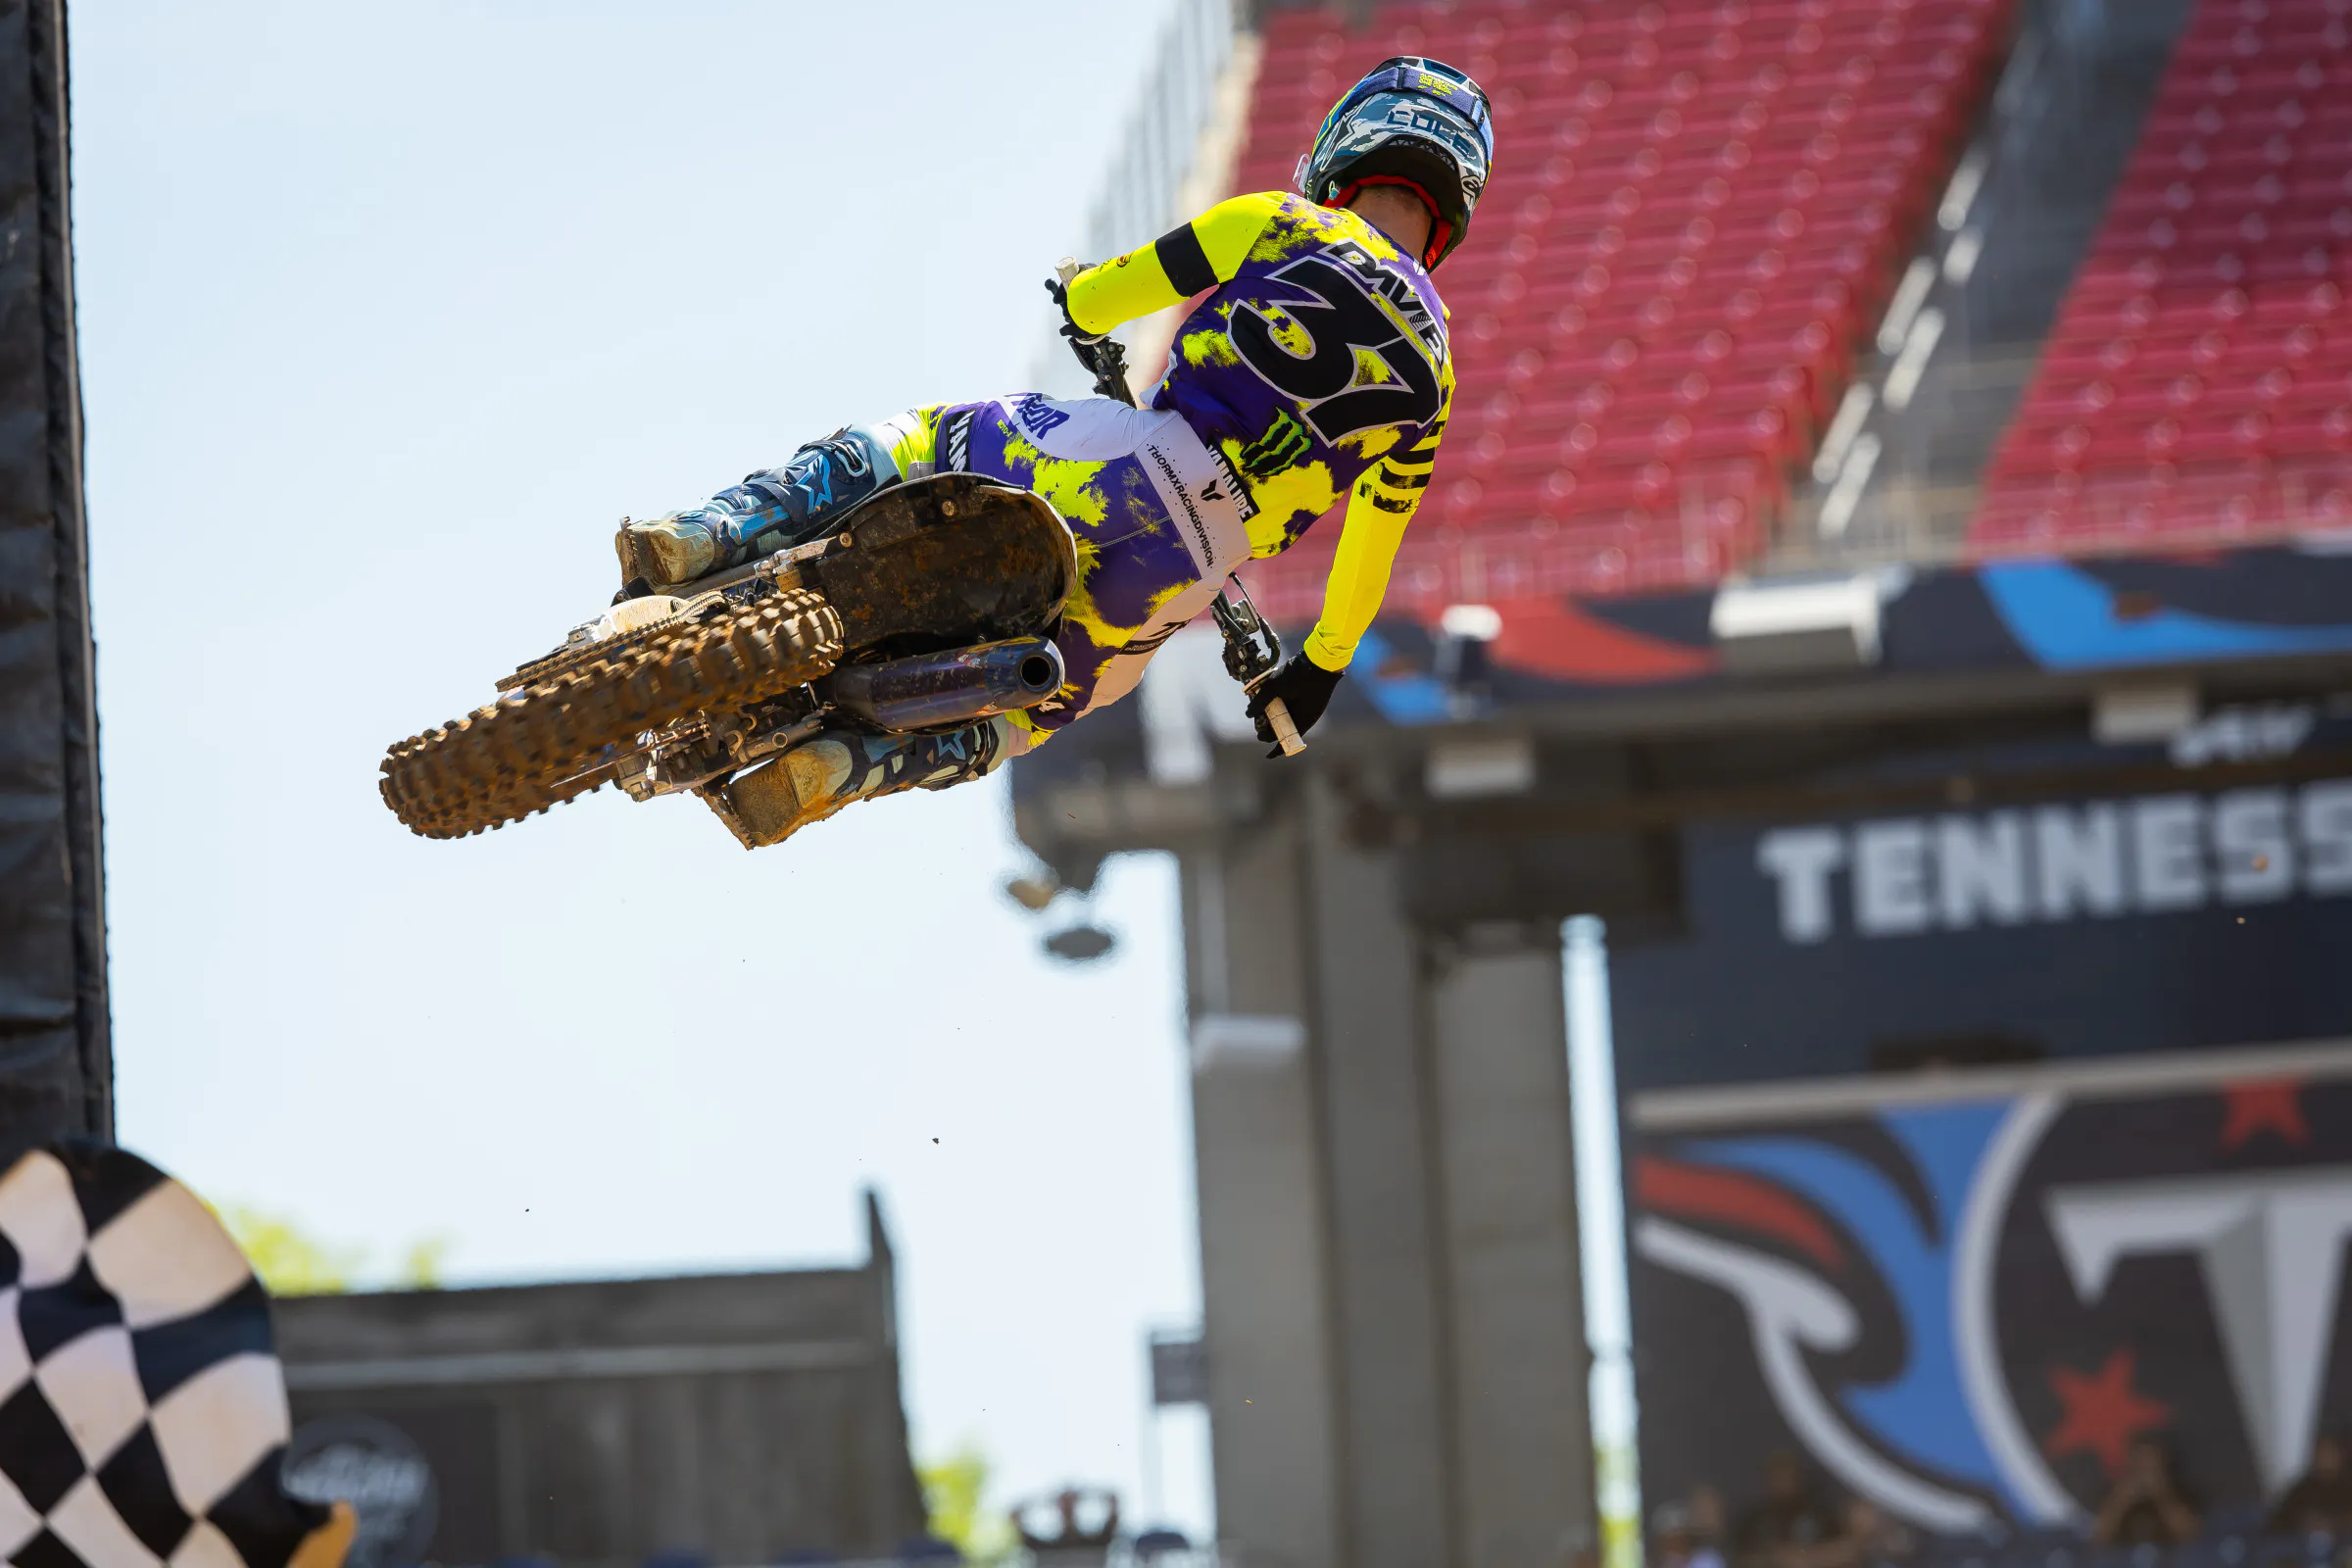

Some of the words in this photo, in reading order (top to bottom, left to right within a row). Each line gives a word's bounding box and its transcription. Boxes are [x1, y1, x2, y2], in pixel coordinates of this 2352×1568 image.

[1387, 110, 1473, 158] COLE
[1228, 256, 1442, 448] 37
[1318, 238, 1446, 372] DAVIE
